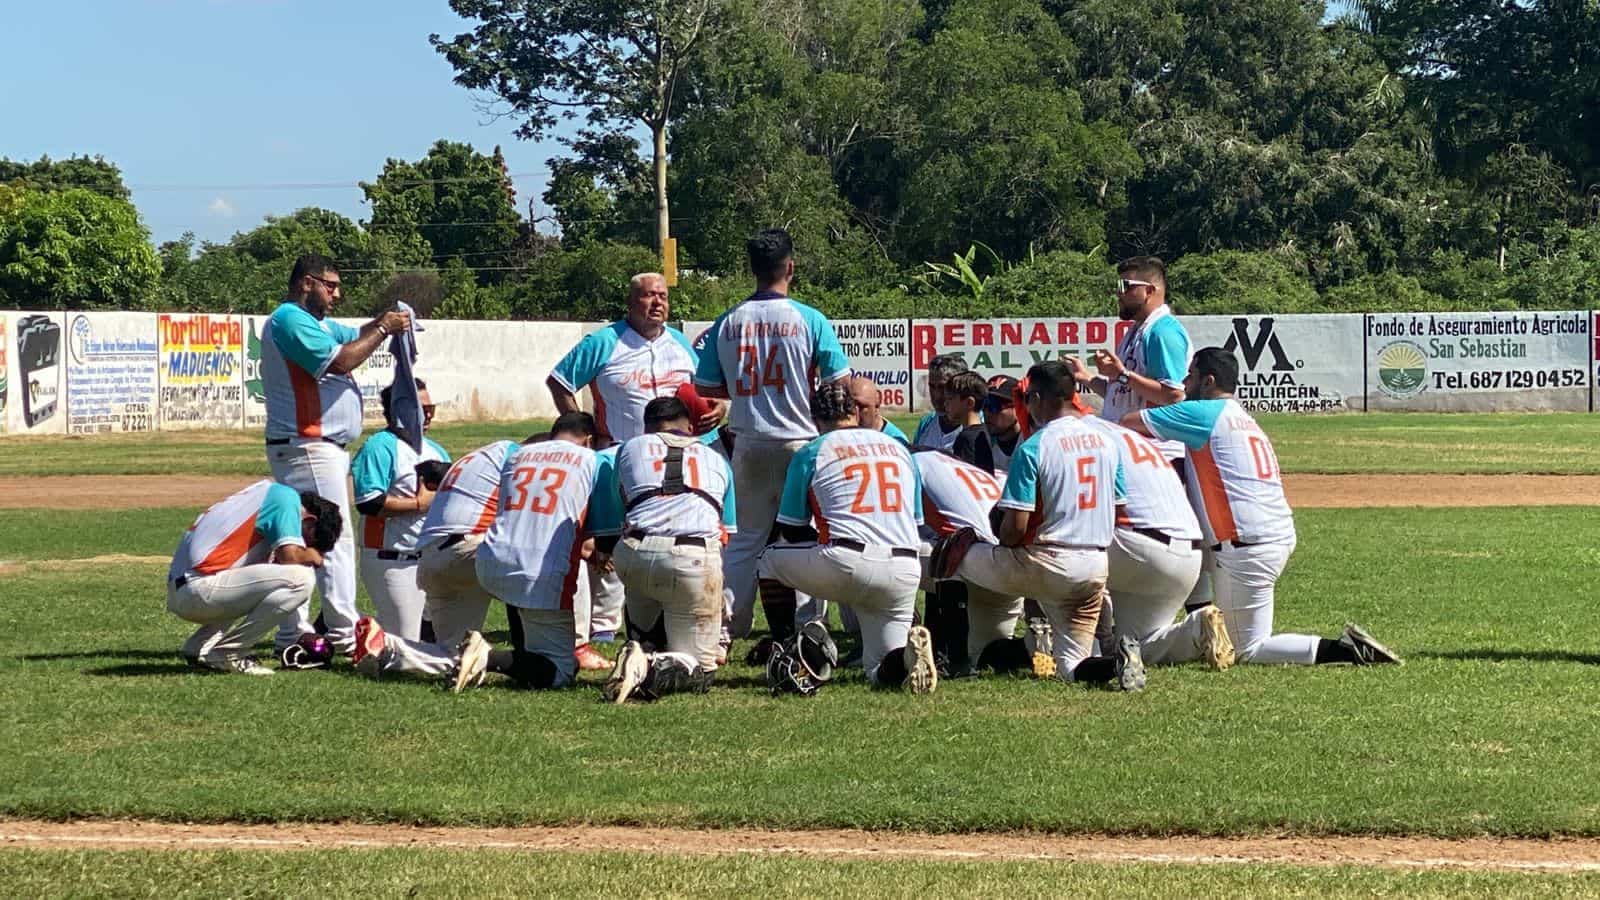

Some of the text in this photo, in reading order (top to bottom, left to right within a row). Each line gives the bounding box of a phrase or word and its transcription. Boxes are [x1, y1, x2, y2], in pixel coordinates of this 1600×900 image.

[1368, 313, 1587, 336] Fondo de Aseguramiento Agricola
[1430, 338, 1527, 359] San Sebastian
[736, 343, 786, 396] 34
[1239, 384, 1320, 399] CULIACÁN
[834, 443, 898, 460] CASTRO
[1060, 433, 1105, 452] RIVERA
[504, 466, 567, 516] 33
[843, 461, 903, 514] 26
[955, 467, 1003, 501] 19
[1076, 456, 1097, 510] 5
